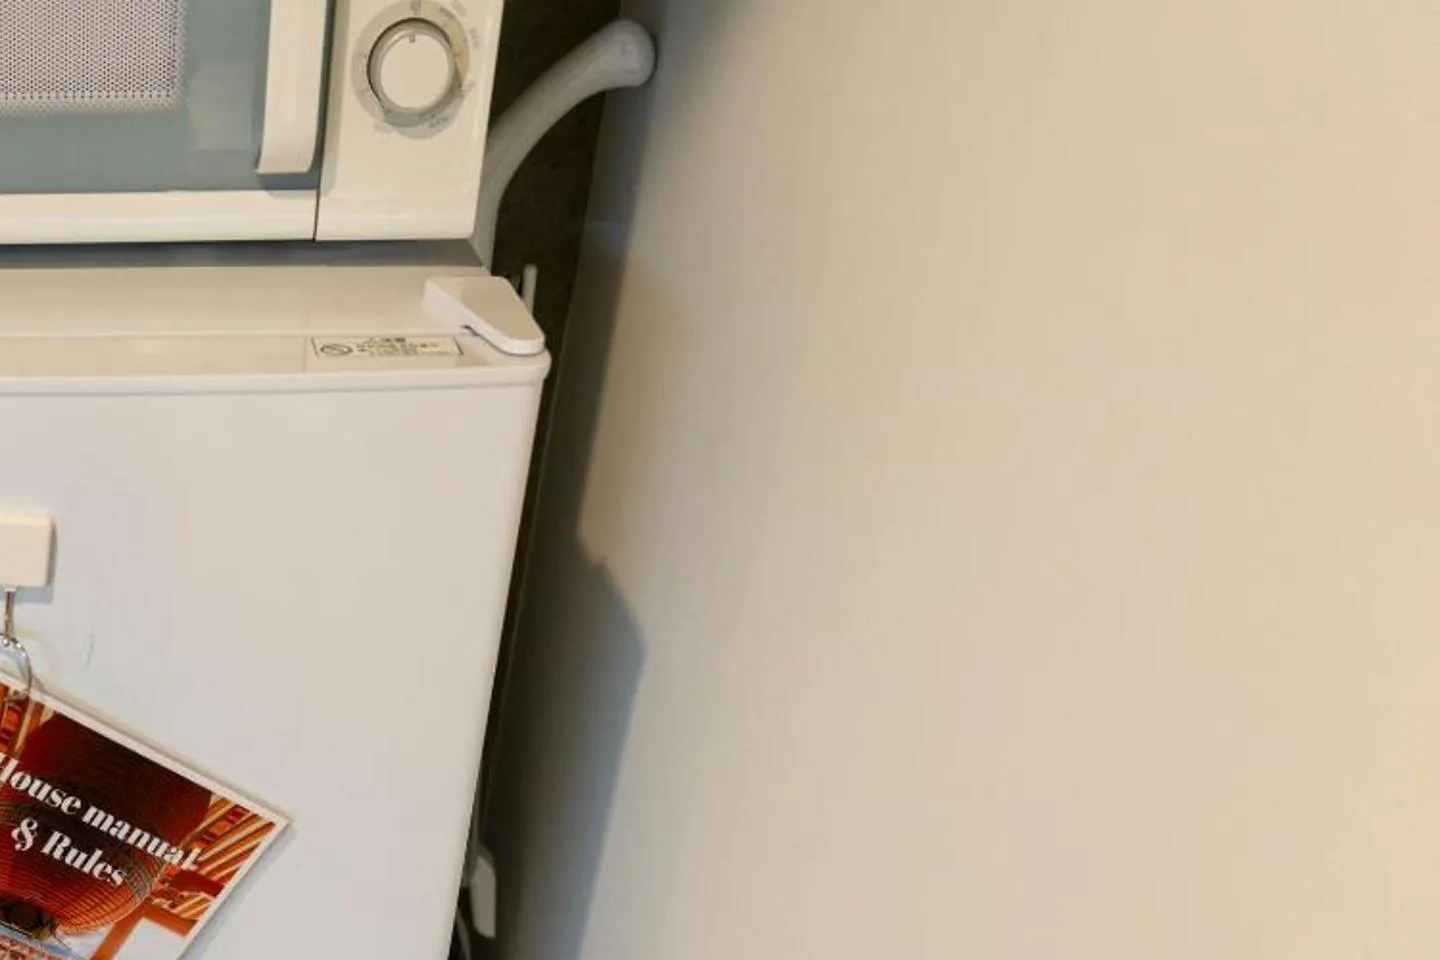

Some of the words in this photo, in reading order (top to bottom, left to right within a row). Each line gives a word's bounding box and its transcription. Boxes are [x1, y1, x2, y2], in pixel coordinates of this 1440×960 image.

[11, 817, 38, 851] &
[41, 831, 127, 886] Rules
[81, 804, 201, 870] manual
